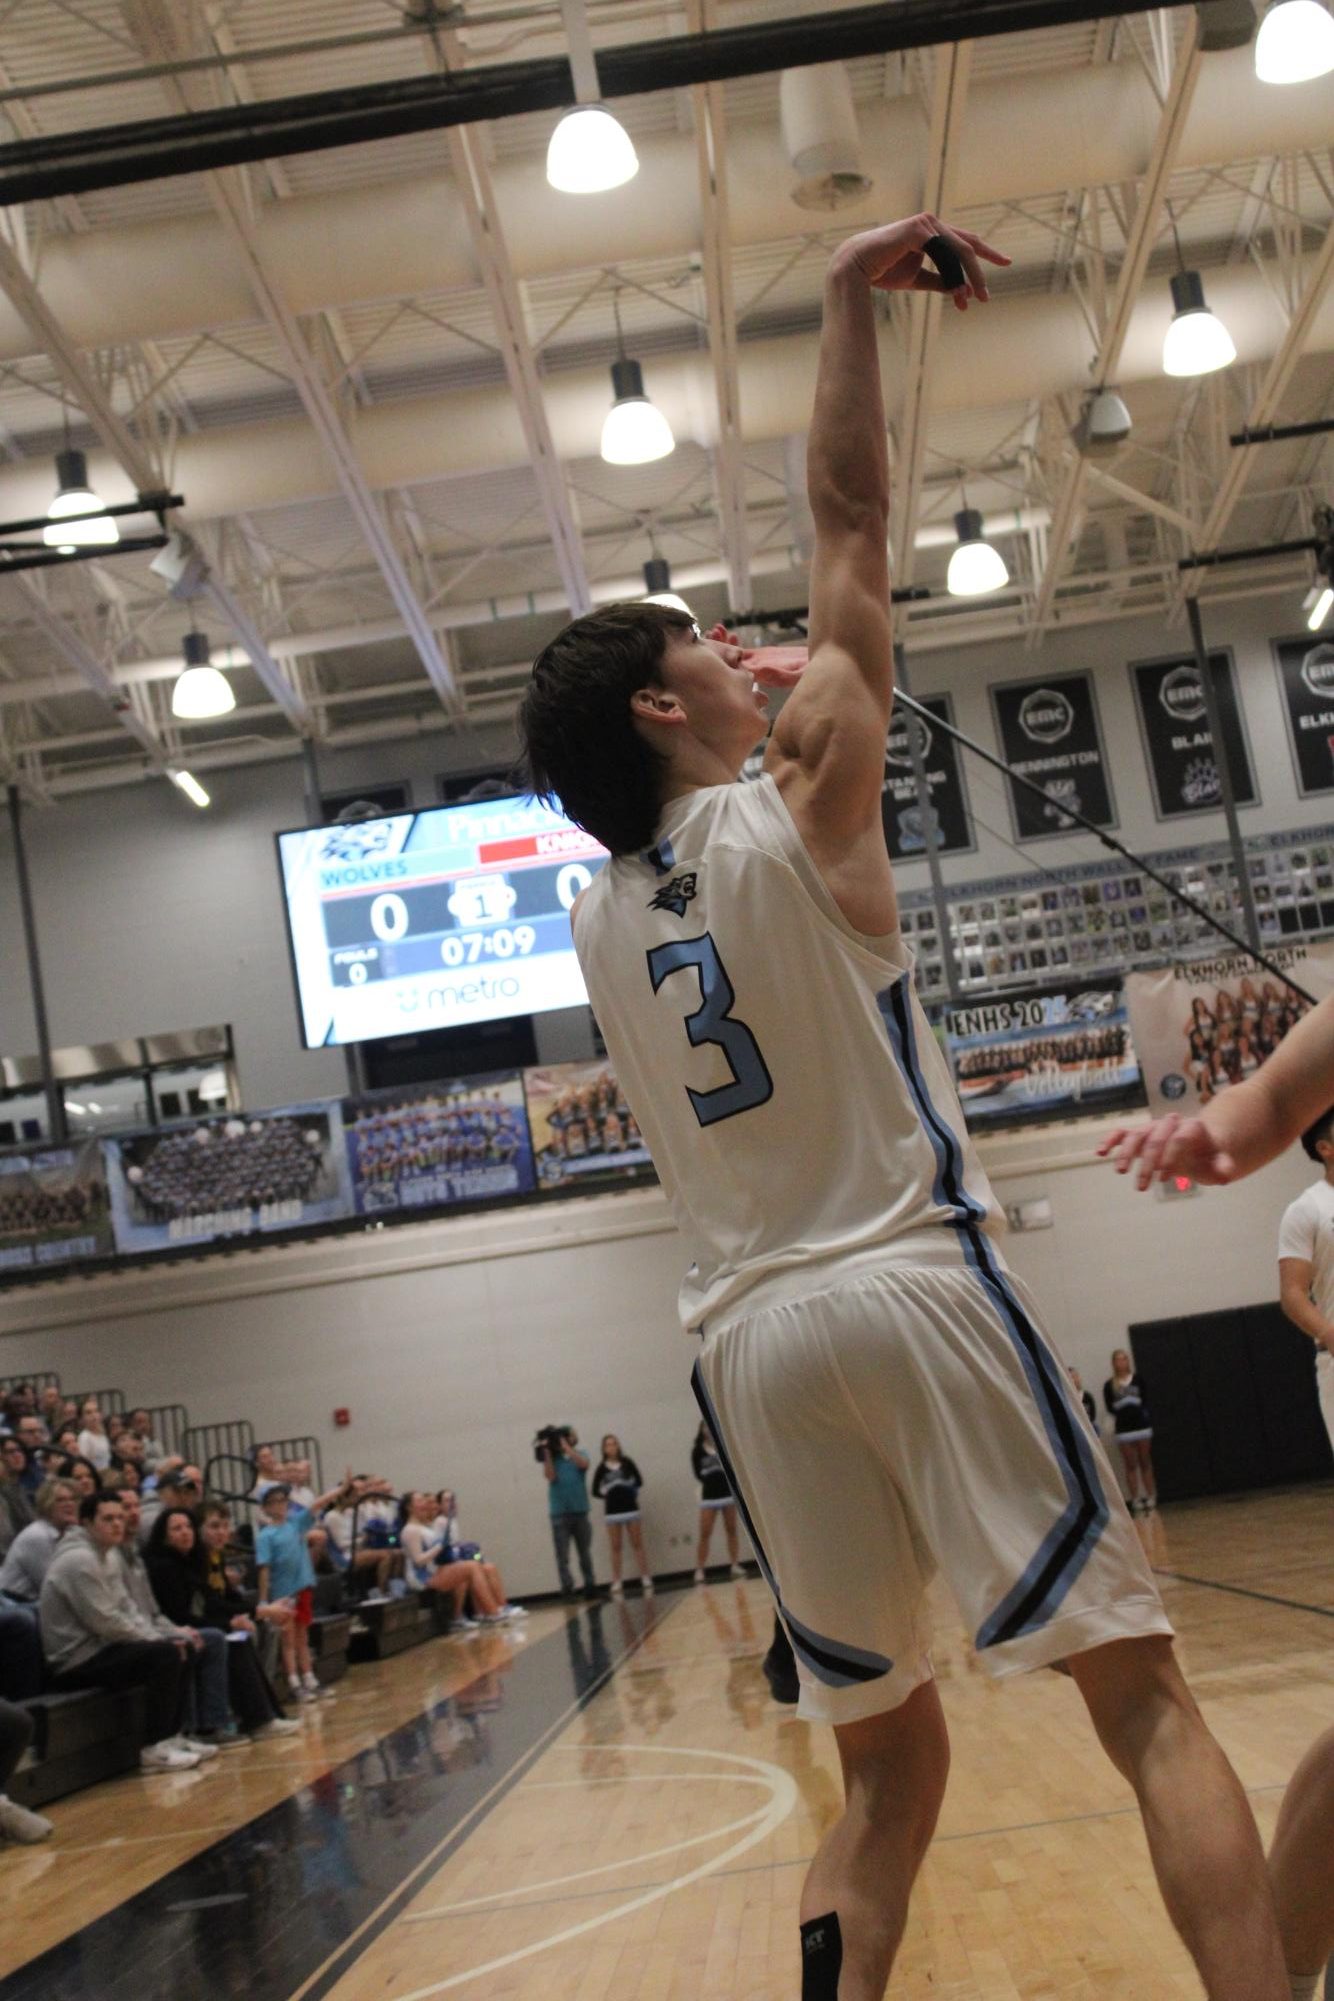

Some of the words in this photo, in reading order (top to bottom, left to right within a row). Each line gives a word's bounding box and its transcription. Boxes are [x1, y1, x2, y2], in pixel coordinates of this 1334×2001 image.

[1299, 711, 1334, 731] ELK
[321, 861, 408, 887] WOLVES
[370, 893, 409, 942] 0
[474, 894, 492, 919] 1
[440, 925, 536, 966] 07:09
[348, 962, 368, 985] 0
[427, 976, 520, 1009] metro
[646, 930, 774, 1128] 3
[953, 1003, 1012, 1037] ENHS
